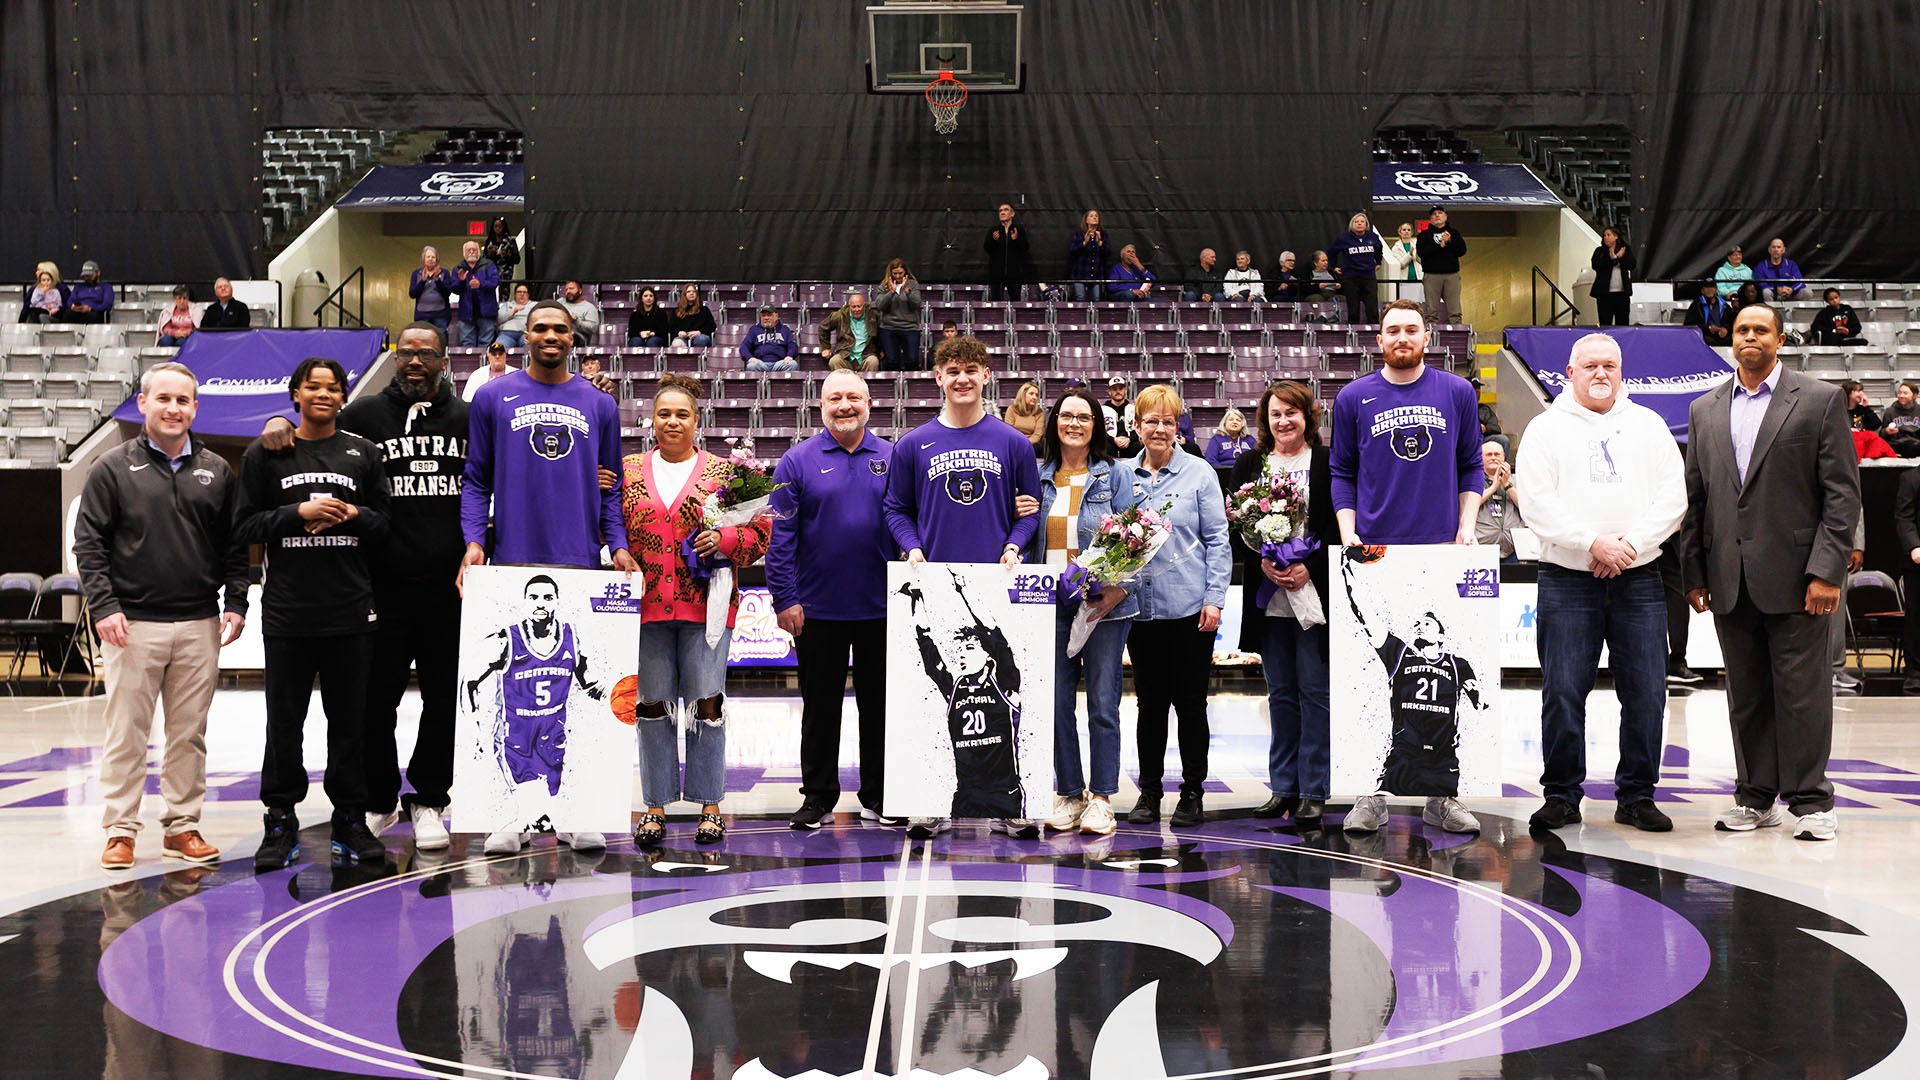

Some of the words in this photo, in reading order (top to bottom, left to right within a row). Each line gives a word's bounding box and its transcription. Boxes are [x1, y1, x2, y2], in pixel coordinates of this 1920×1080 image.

[206, 376, 277, 386] CONWAY
[1646, 369, 1732, 385] REGIONAL
[514, 403, 586, 421] CENTRAL
[1374, 405, 1442, 424] CENTRAL
[510, 412, 590, 433] ARKANSAS
[1370, 414, 1447, 435] ARKANSAS
[413, 462, 435, 471] 1907
[929, 449, 998, 467] CENTRAL
[927, 457, 1002, 479] ARKANSAS
[280, 472, 357, 491] CENTRAL
[1014, 574, 1055, 592] #20
[1463, 568, 1498, 586] #21
[604, 583, 632, 600] #5
[514, 666, 572, 680] CENTRAL
[1404, 665, 1452, 681] CENTRAL
[535, 680, 552, 706] 5
[1415, 677, 1439, 701] 21
[1401, 702, 1450, 715] ARKANSAS
[962, 709, 987, 736] 20
